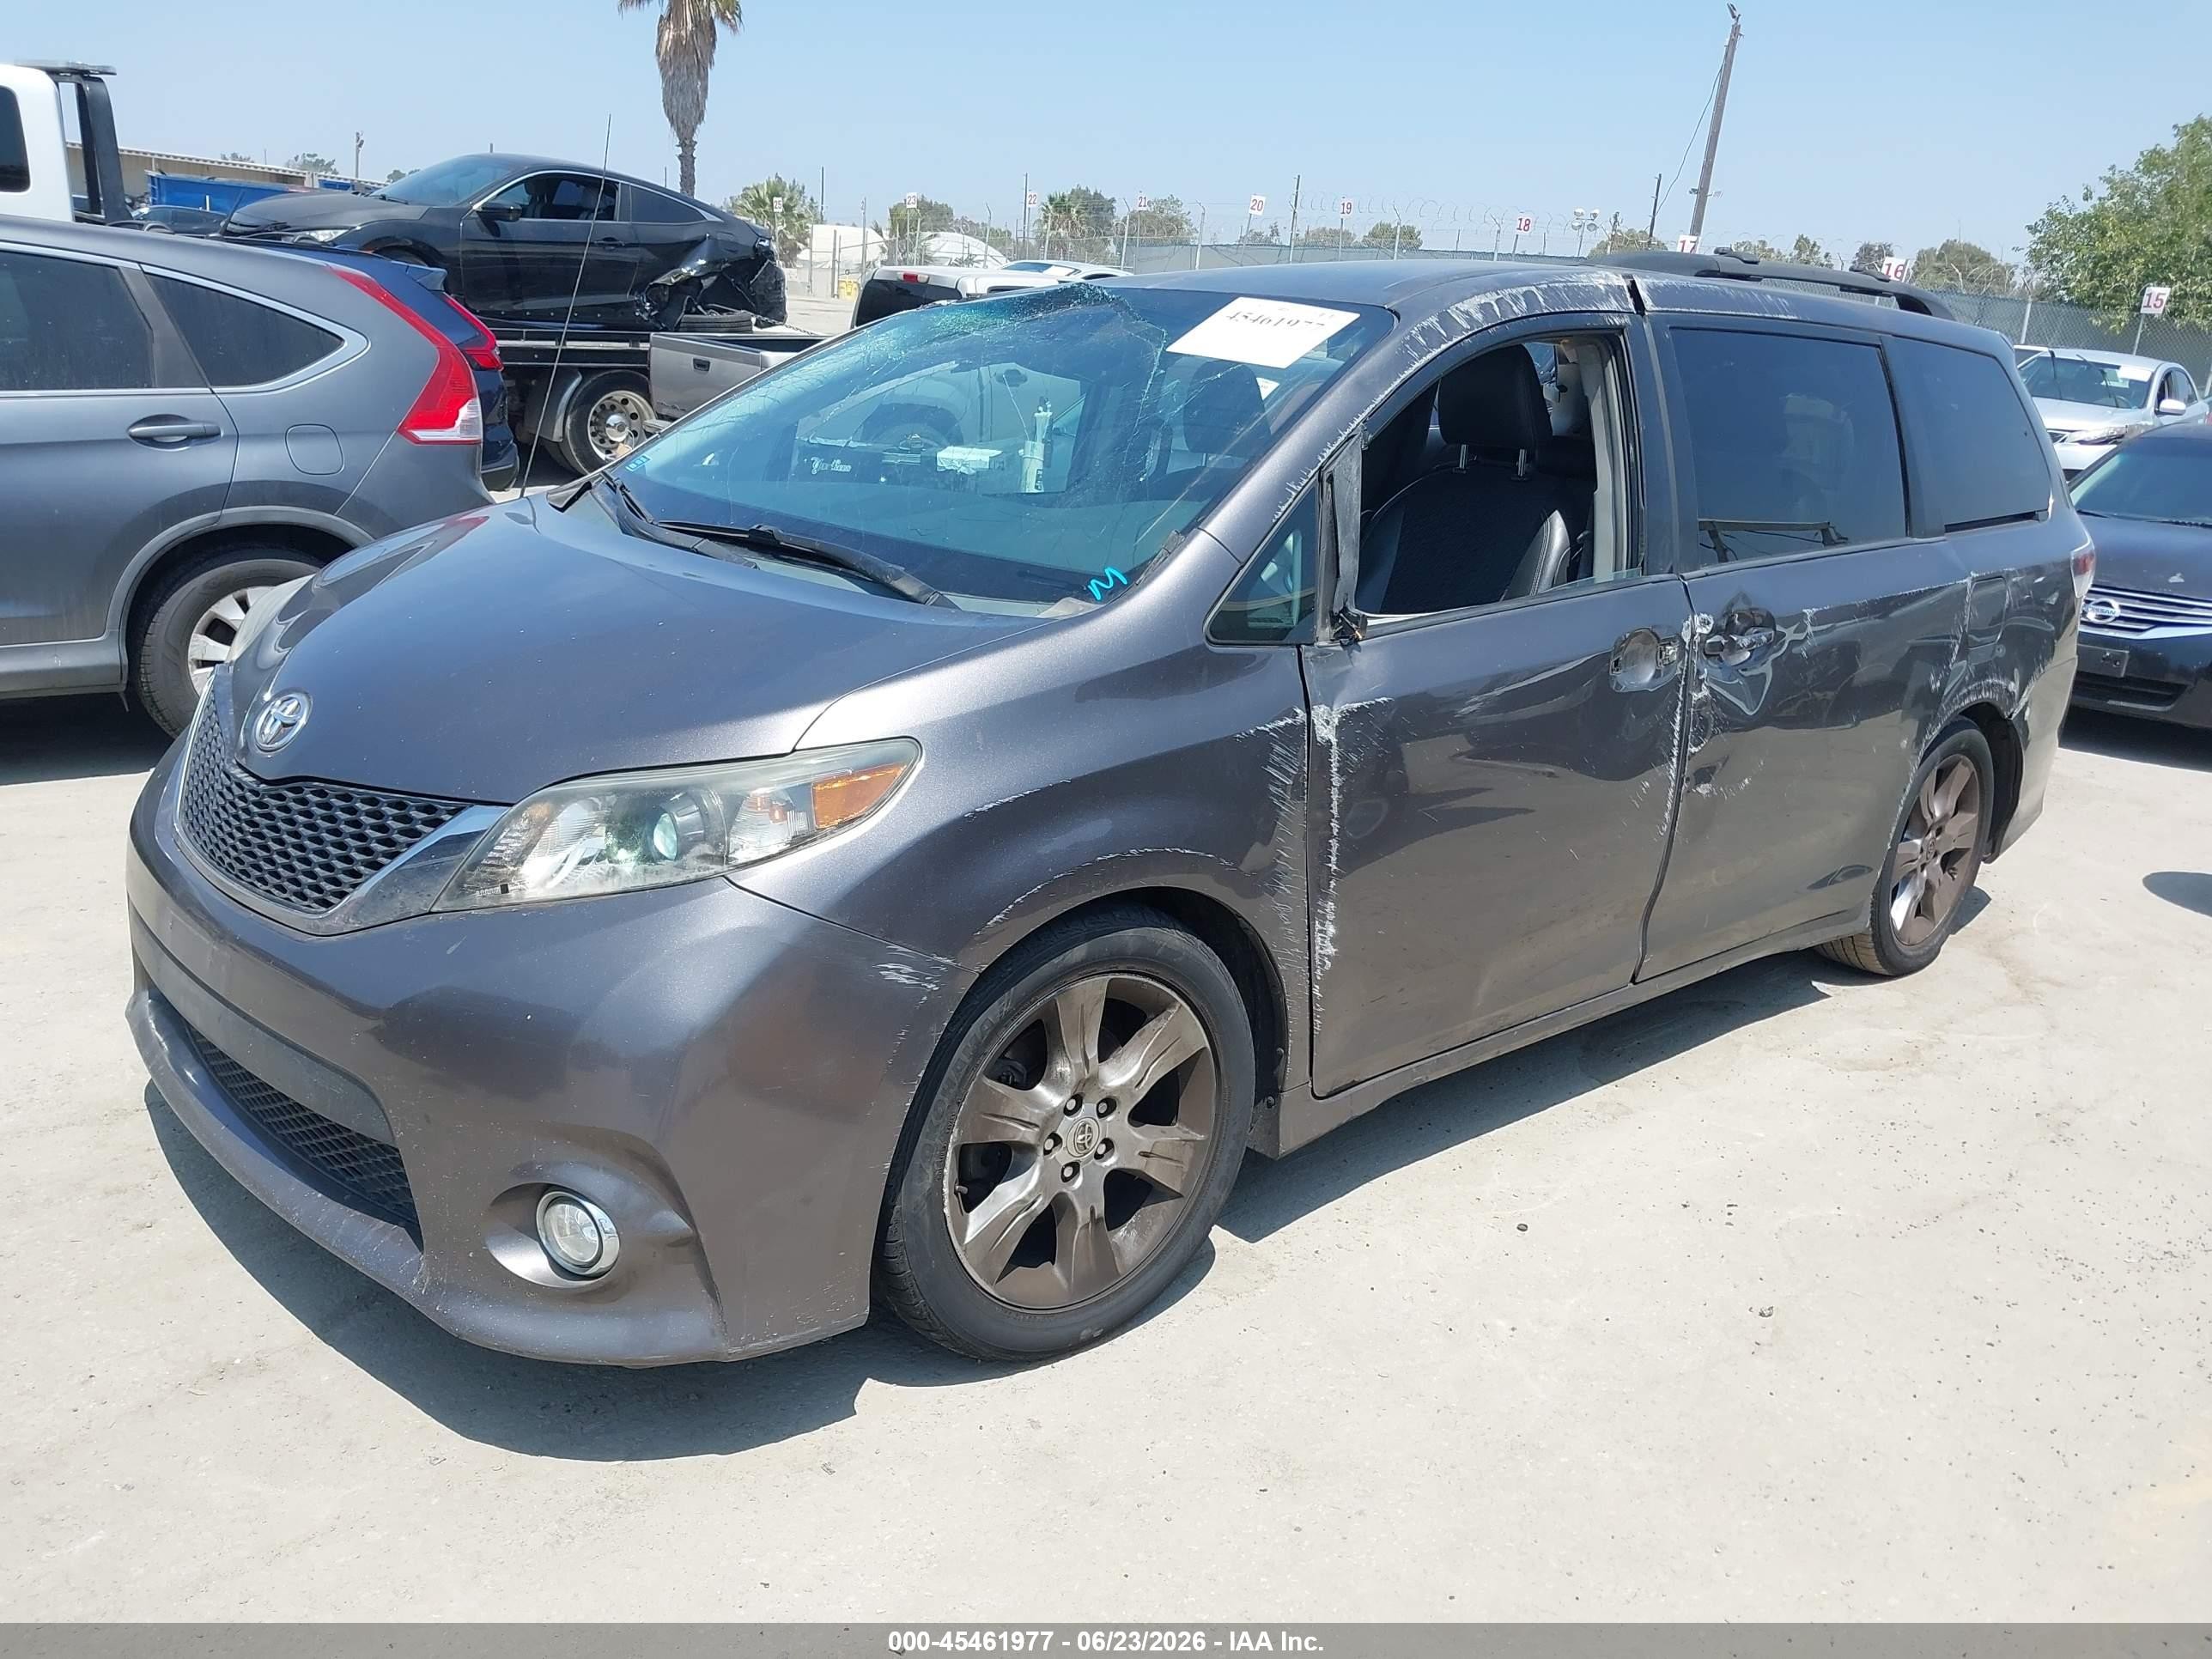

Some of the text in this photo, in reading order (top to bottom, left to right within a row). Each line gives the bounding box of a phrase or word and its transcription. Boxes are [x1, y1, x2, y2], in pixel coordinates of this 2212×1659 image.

[774, 200, 783, 210] 25
[907, 195, 916, 205] 23
[1028, 194, 1037, 205] 22
[1139, 196, 1148, 208] 21
[1250, 198, 1264, 212] 20
[1340, 202, 1352, 215] 19
[1516, 217, 1531, 232] 18
[1680, 240, 1697, 254] 17
[1885, 263, 1905, 279] 16
[2143, 292, 2166, 309] 15
[1087, 567, 1127, 600] M
